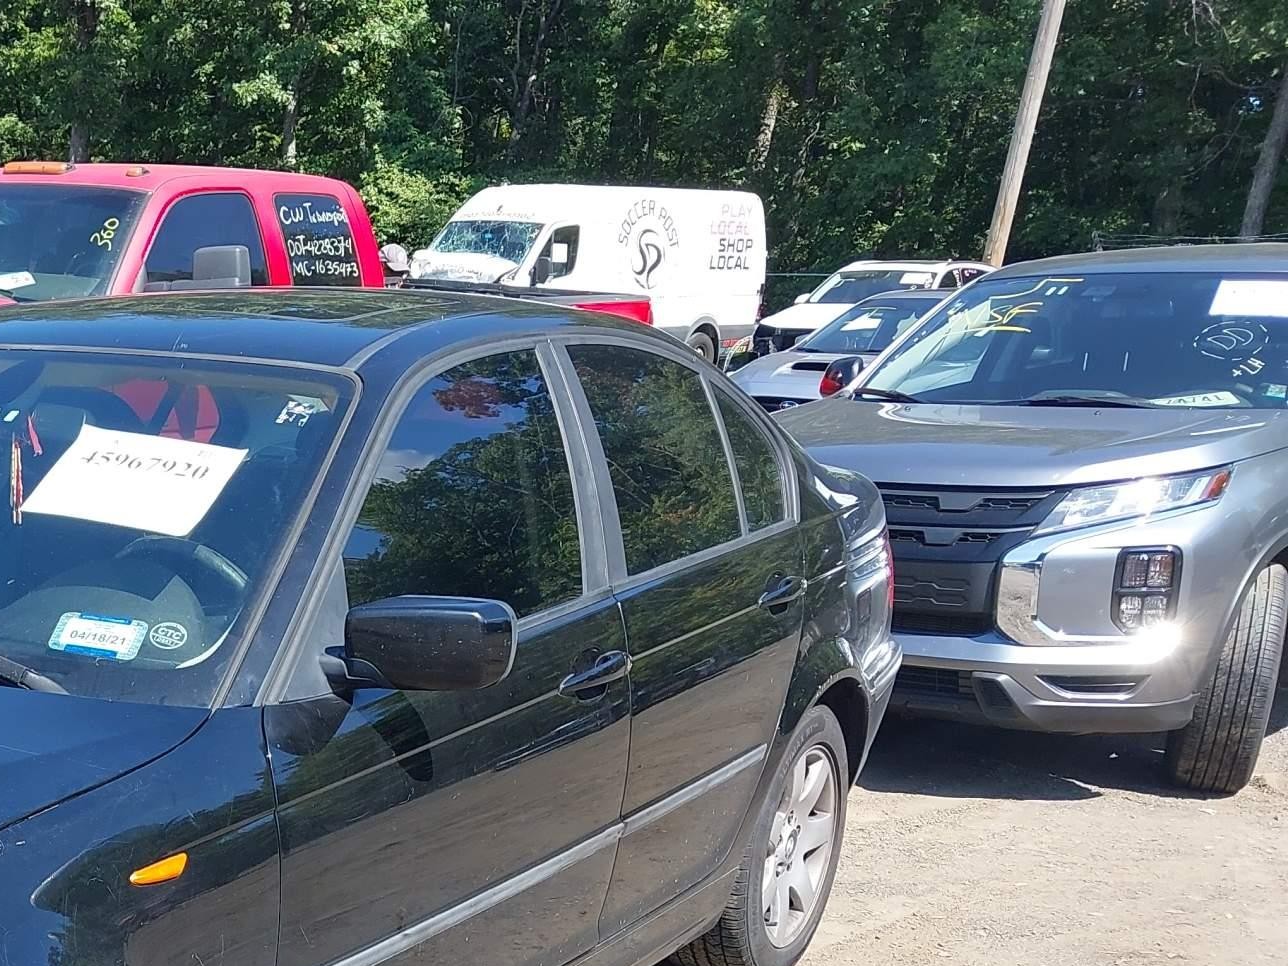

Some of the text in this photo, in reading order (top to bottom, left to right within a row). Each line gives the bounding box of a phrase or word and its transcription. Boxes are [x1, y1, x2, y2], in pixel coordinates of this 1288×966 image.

[721, 203, 753, 218] PLAY
[617, 199, 680, 249] SOCCER POST
[710, 220, 751, 235] LOCAL
[717, 237, 754, 253] SHOP
[292, 258, 360, 278] MC-1635473
[709, 254, 751, 270] LOCAL
[81, 450, 210, 480] 45967920
[69, 629, 127, 647] 04/18/21
